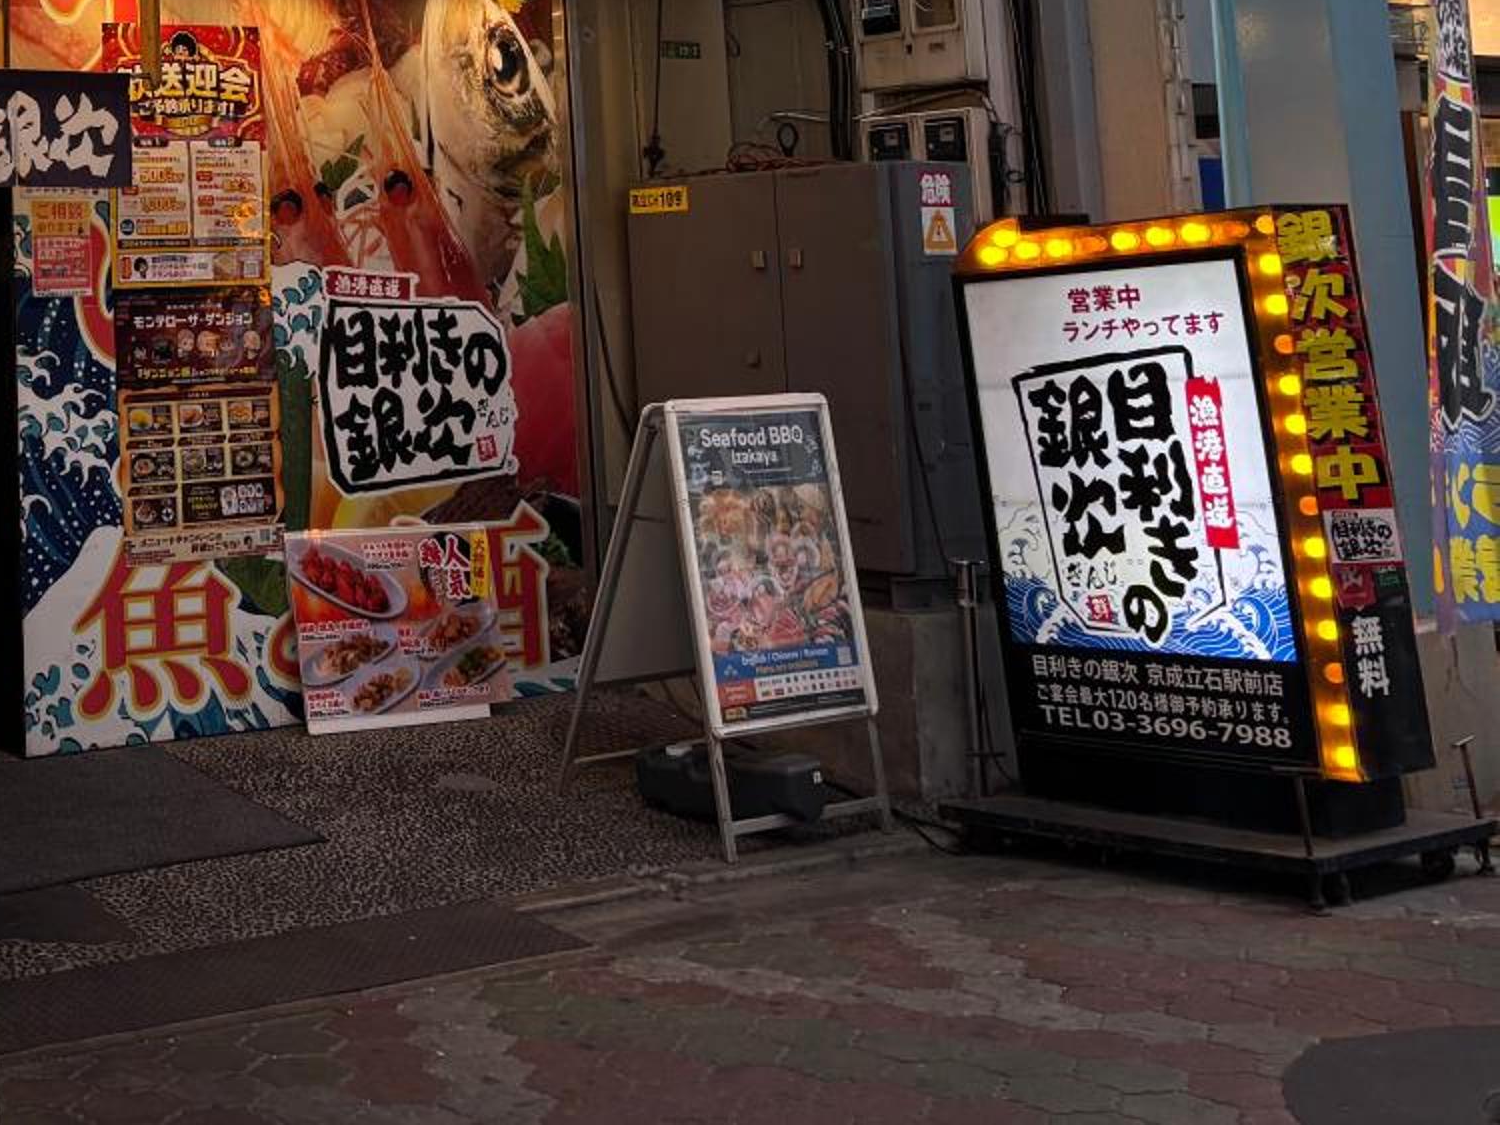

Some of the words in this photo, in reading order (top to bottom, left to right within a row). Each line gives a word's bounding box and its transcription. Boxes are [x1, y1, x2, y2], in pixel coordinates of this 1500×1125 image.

[1062, 311, 1225, 342] ランチやってます
[1067, 284, 1141, 313] 営業中
[333, 307, 508, 397] 目利きの
[1276, 210, 1381, 500] 銀次営業中
[335, 385, 477, 481] 銀次
[701, 427, 766, 448] Seafood
[769, 425, 804, 446] BBQ
[731, 449, 778, 465] Izakaya
[1189, 395, 1230, 527] 漁港直送
[1107, 362, 1199, 643] 目利きの
[1032, 655, 1141, 685] 目利きの銀次
[1148, 663, 1284, 698] 京成立石駅前店
[1351, 615, 1390, 699] 無料
